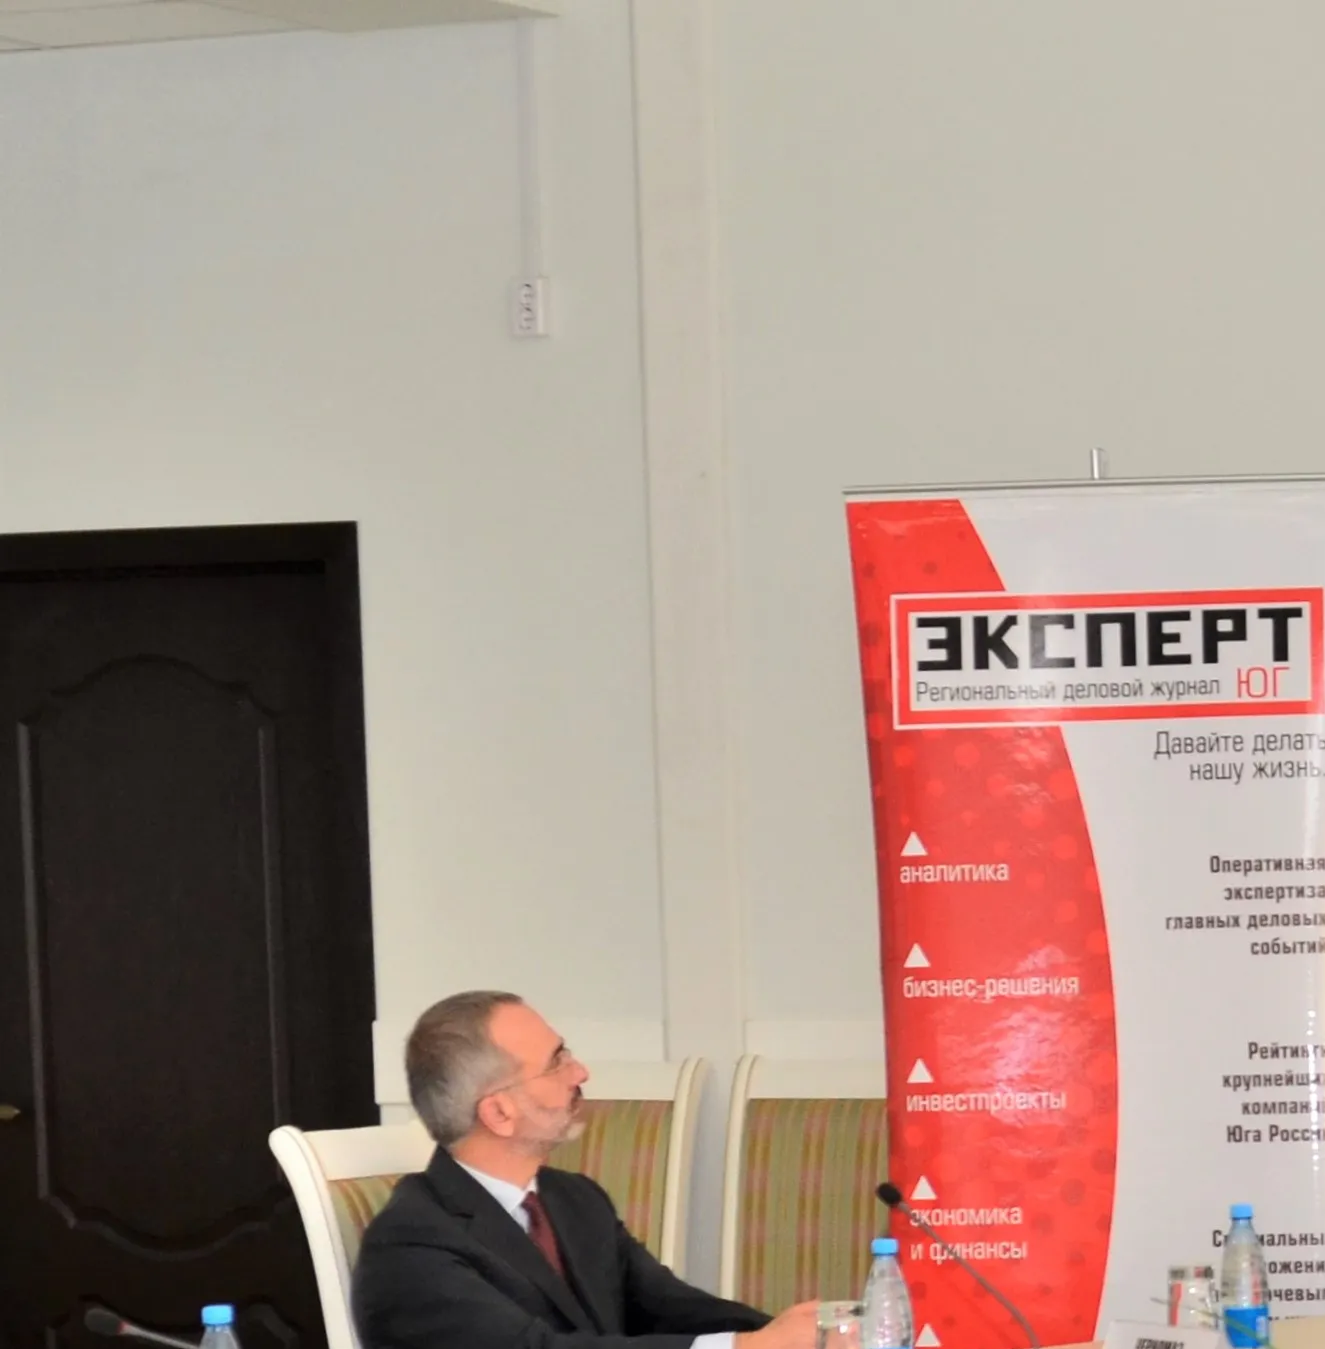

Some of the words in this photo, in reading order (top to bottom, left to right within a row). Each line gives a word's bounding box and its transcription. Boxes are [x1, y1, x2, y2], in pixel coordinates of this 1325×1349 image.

[915, 607, 1303, 671] ЭКСПЕРТ
[916, 679, 1056, 703] Региональный
[1062, 678, 1144, 703] деловой
[1149, 678, 1221, 702] журнал
[1236, 666, 1290, 698] ЮГ
[1153, 730, 1245, 760] Давайте
[1189, 761, 1245, 785] нашу
[899, 860, 1009, 884] аналитика
[1165, 914, 1241, 930] главных
[902, 976, 1080, 1000] бизнес-решения
[905, 1091, 1067, 1114] инвестпроекты
[1226, 1124, 1262, 1143] Юга
[909, 1206, 1023, 1227] экономика
[910, 1243, 924, 1261] и
[929, 1241, 1028, 1265] финансы
